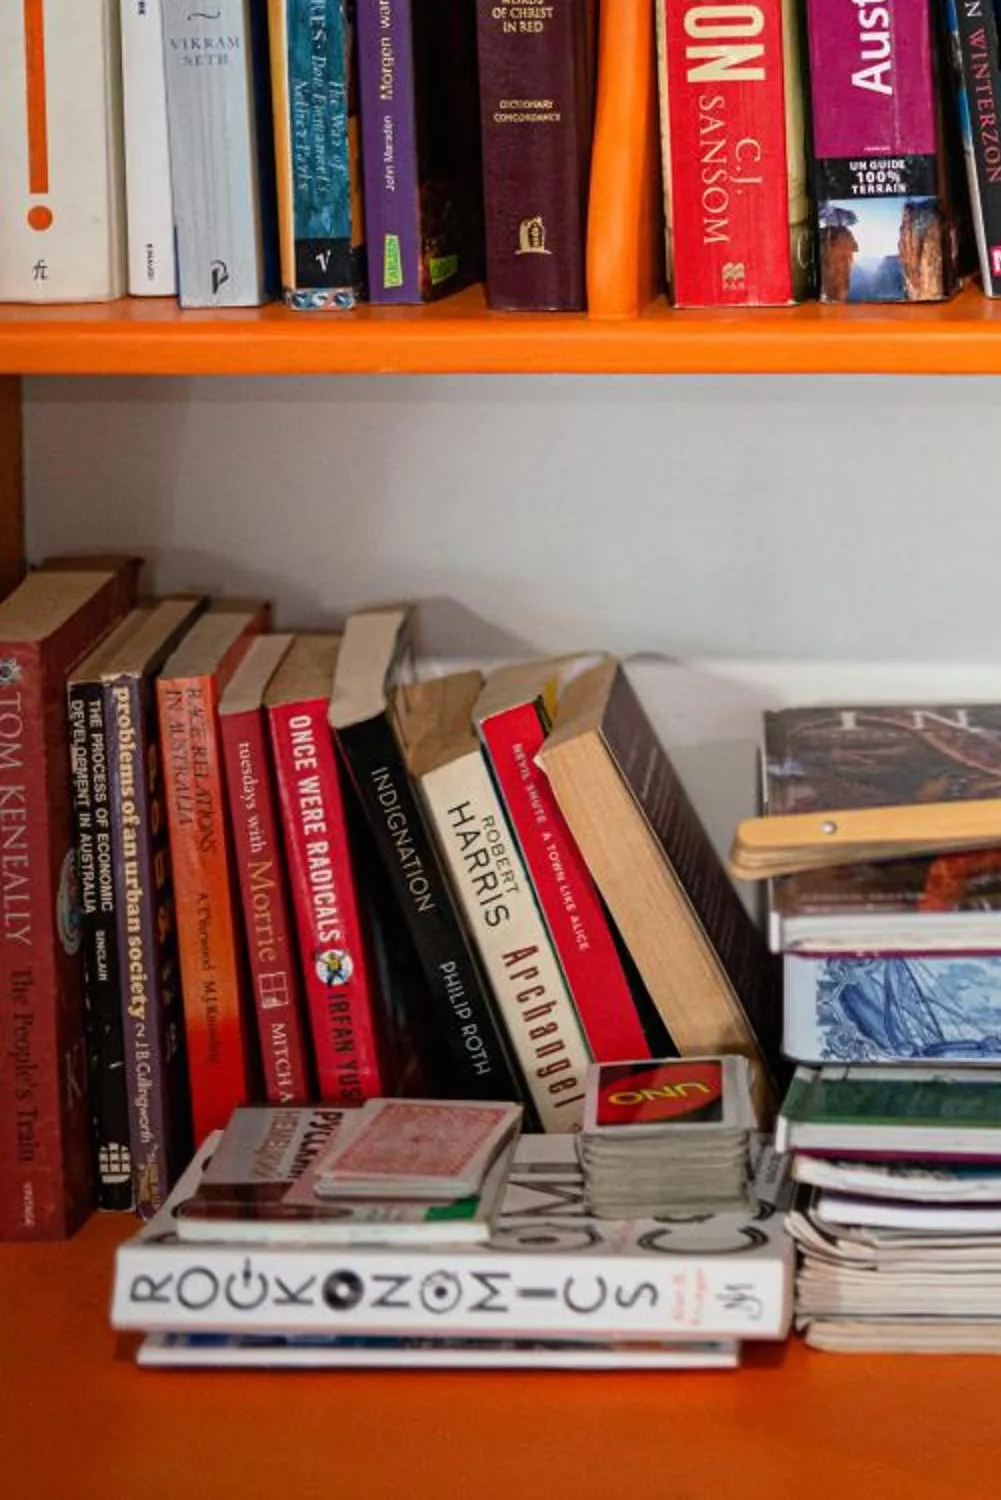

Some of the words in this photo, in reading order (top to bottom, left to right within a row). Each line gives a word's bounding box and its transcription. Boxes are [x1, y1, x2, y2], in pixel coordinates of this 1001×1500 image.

[379, 0, 393, 30] war
[492, 8, 507, 19] OF
[510, 7, 554, 19] CHRIST
[503, 22, 516, 32] IN
[520, 21, 544, 33] RED
[181, 54, 229, 68] SETH
[379, 36, 395, 100] Morgen
[384, 168, 396, 192] John
[700, 94, 730, 245] SANSOM
[849, 161, 867, 171] UN
[869, 159, 905, 170] GUIDE
[852, 184, 907, 195] TERRAIN
[857, 171, 901, 184] 100%
[0, 691, 24, 769] TOM
[89, 699, 103, 727] THE
[115, 685, 137, 797] problems
[70, 699, 91, 807] DEVELOPMENT
[91, 733, 108, 804] PROCESS
[289, 715, 318, 771] ONCE
[79, 812, 91, 828] IN
[96, 808, 109, 828] OF
[121, 801, 140, 826] of
[247, 815, 267, 853] with
[297, 776, 326, 836] WERE
[0, 785, 32, 946] KENEALLY
[371, 766, 436, 913] INDIGNATION
[447, 800, 510, 929] HARRIS
[482, 814, 520, 894] ROBERT
[541, 832, 553, 841] A
[546, 844, 567, 881] TOWN
[80, 833, 97, 914] AUSTRALIA
[97, 832, 114, 913] ECONOMIC
[306, 841, 343, 943] RADICALS
[559, 883, 578, 913] LIKE
[248, 861, 285, 962] Morrie
[570, 915, 590, 950] ALICE
[128, 937, 148, 1021] society
[328, 993, 354, 1055] IRFAN
[439, 960, 473, 1020] PHILIP
[461, 1024, 492, 1076] ROTH
[502, 945, 587, 1109] Archangel
[272, 1023, 292, 1086] MITCH
[608, 1081, 712, 1105] UNO
[129, 1258, 659, 1314] ROCKONOMICS
